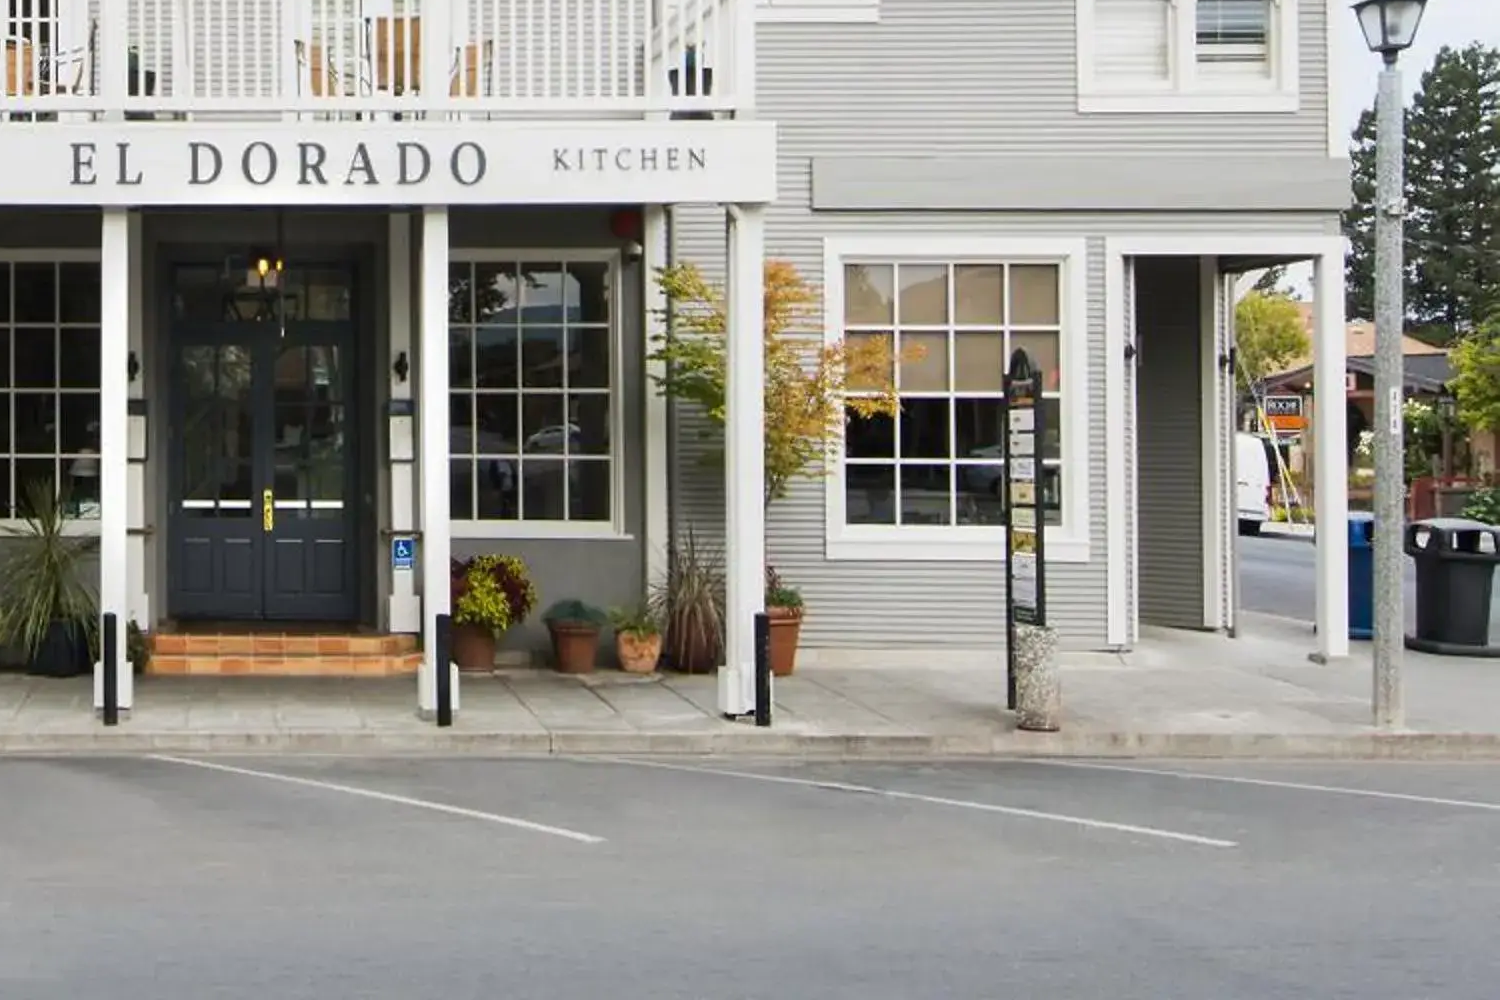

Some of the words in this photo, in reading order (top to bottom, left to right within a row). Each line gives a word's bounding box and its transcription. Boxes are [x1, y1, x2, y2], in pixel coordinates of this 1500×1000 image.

[69, 142, 143, 186] EL
[187, 140, 487, 186] DORADO
[552, 147, 706, 171] KITCHEN
